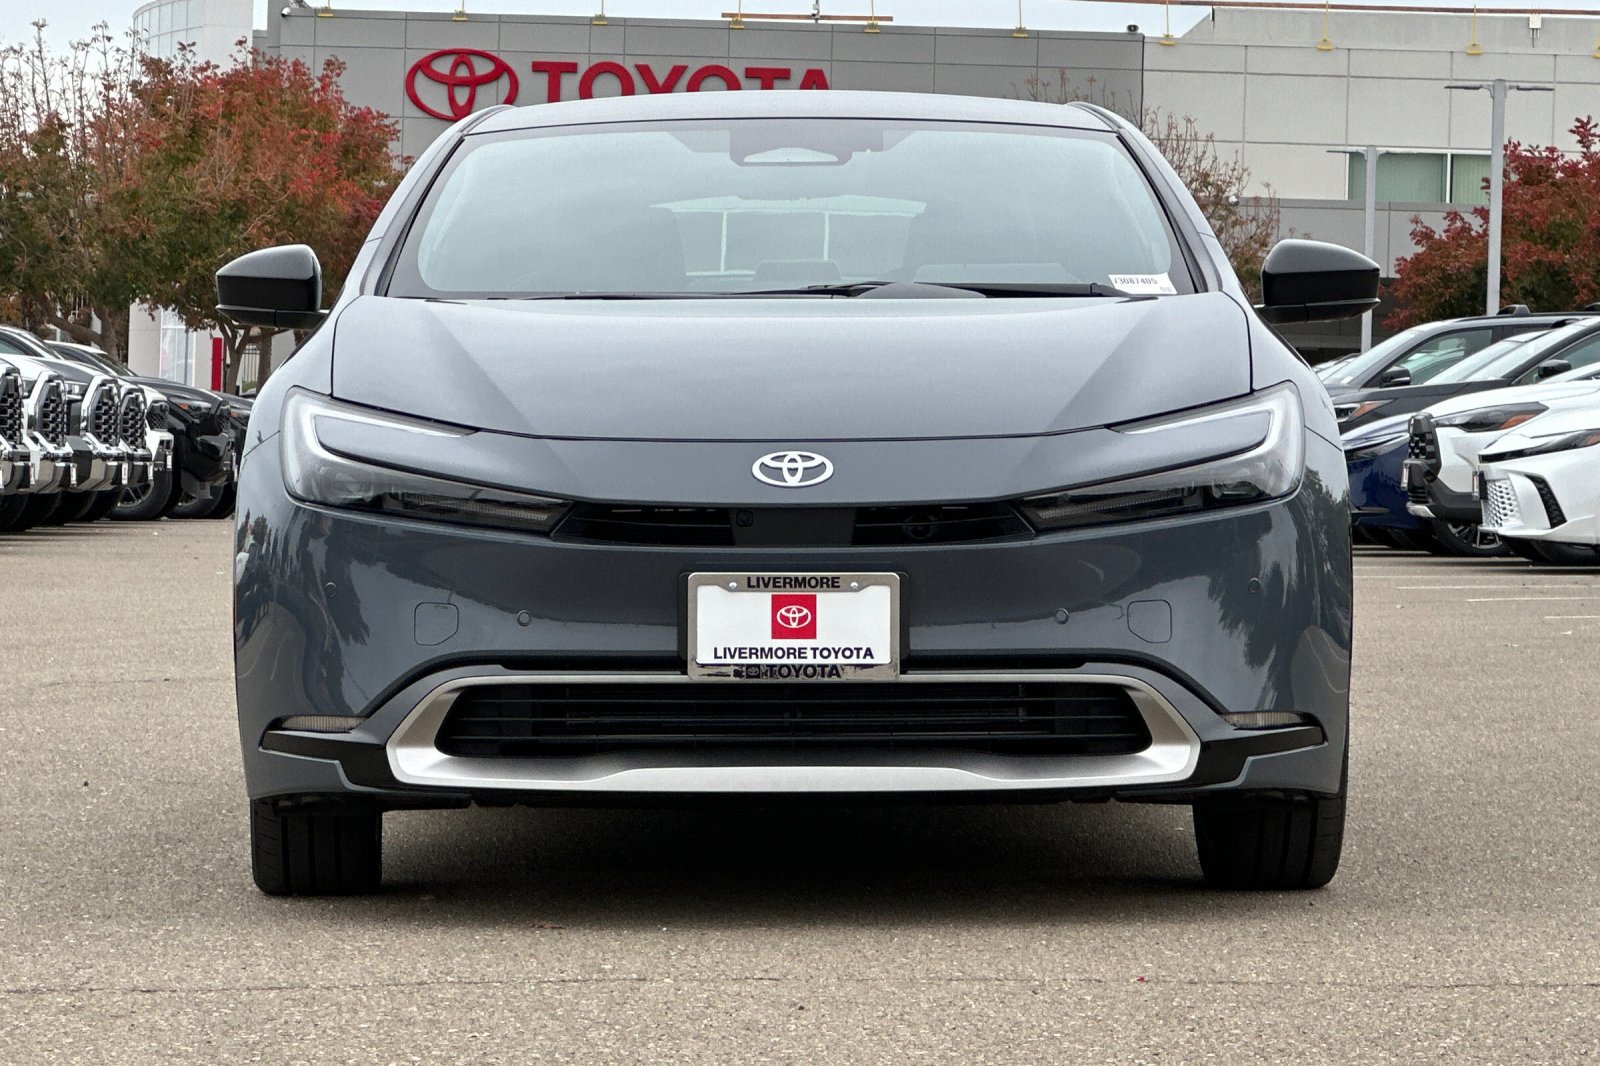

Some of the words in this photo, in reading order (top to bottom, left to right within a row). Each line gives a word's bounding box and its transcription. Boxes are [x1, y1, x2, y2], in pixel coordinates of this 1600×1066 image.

[747, 576, 841, 589] LIVERMORE
[713, 647, 808, 660] LIVERMORE
[810, 647, 875, 660] TOYOTA
[767, 664, 842, 679] TOYOTA
